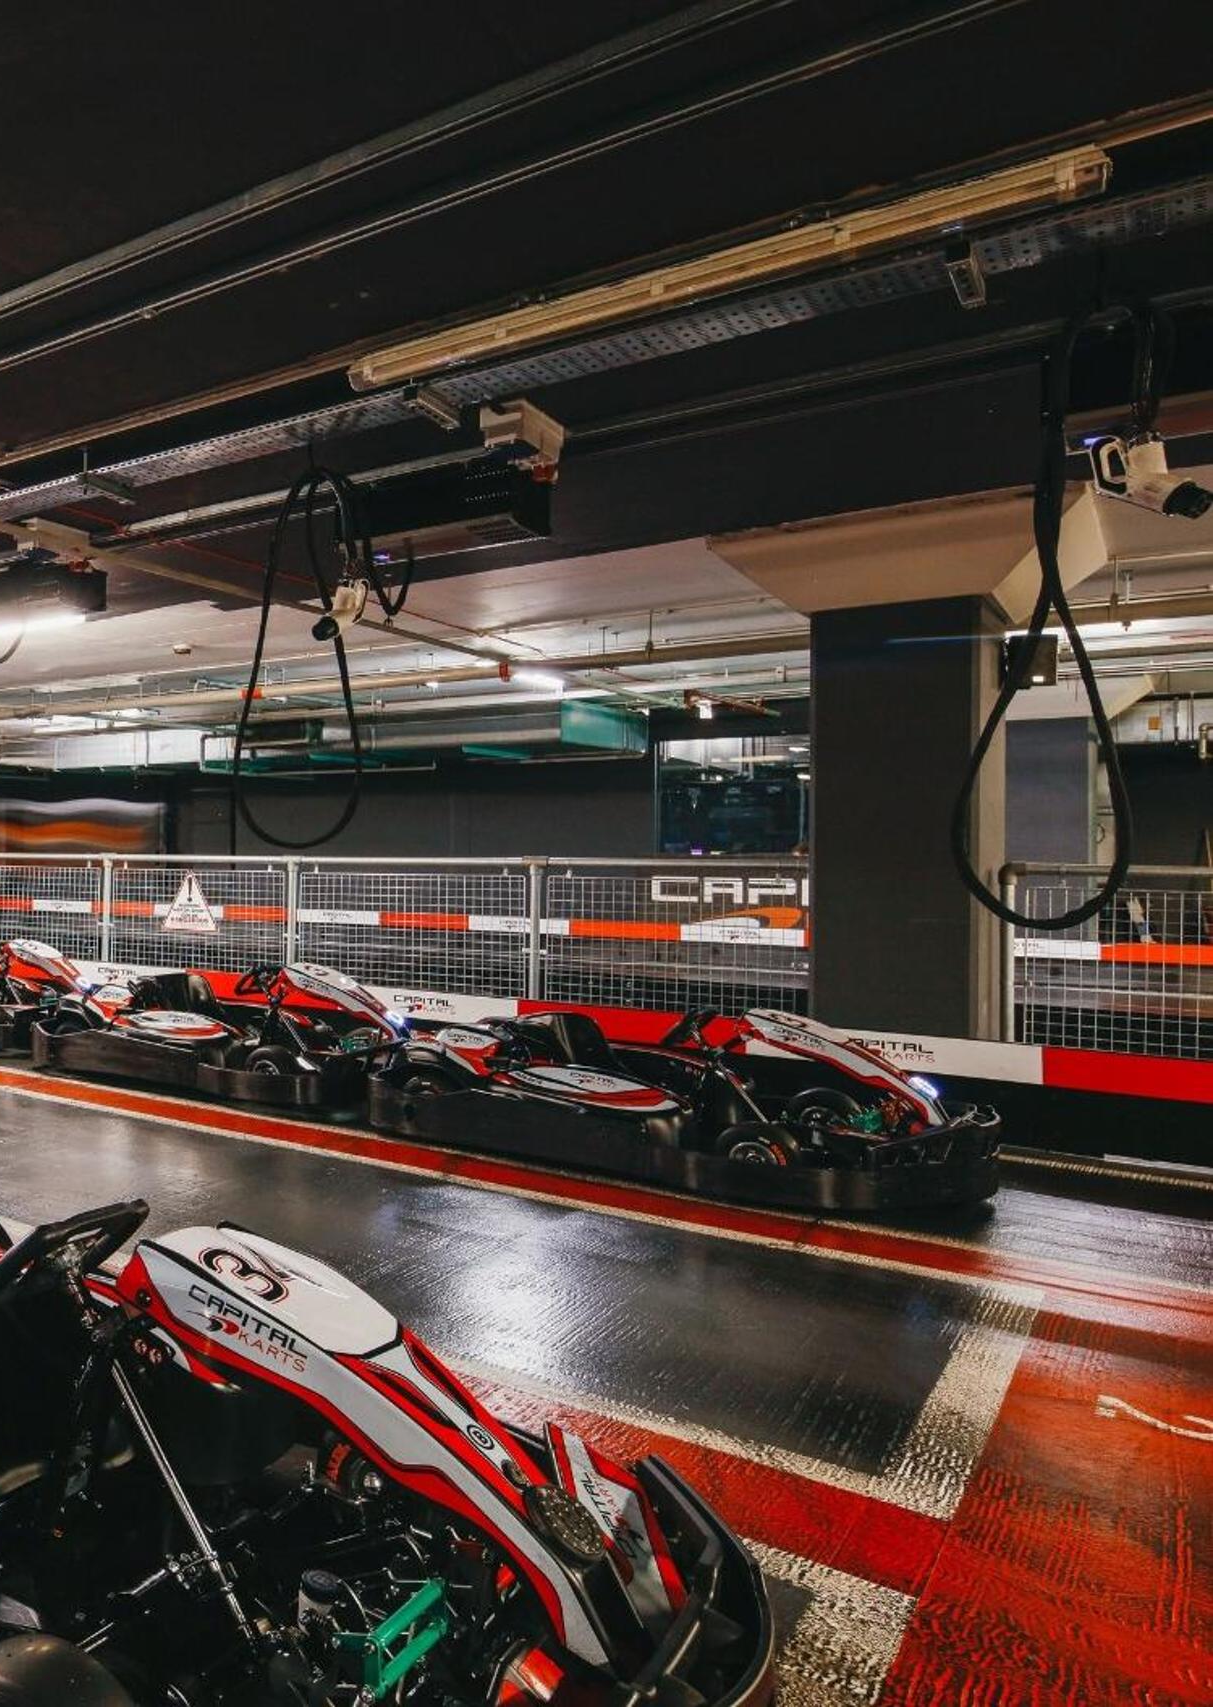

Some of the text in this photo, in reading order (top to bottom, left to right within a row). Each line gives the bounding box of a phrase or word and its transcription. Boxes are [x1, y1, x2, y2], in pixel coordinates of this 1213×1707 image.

[394, 995, 454, 1008] CAPITAL
[882, 1050, 936, 1063] KARTS
[188, 1284, 308, 1360] CAPITAL
[238, 1331, 306, 1373] KARTS
